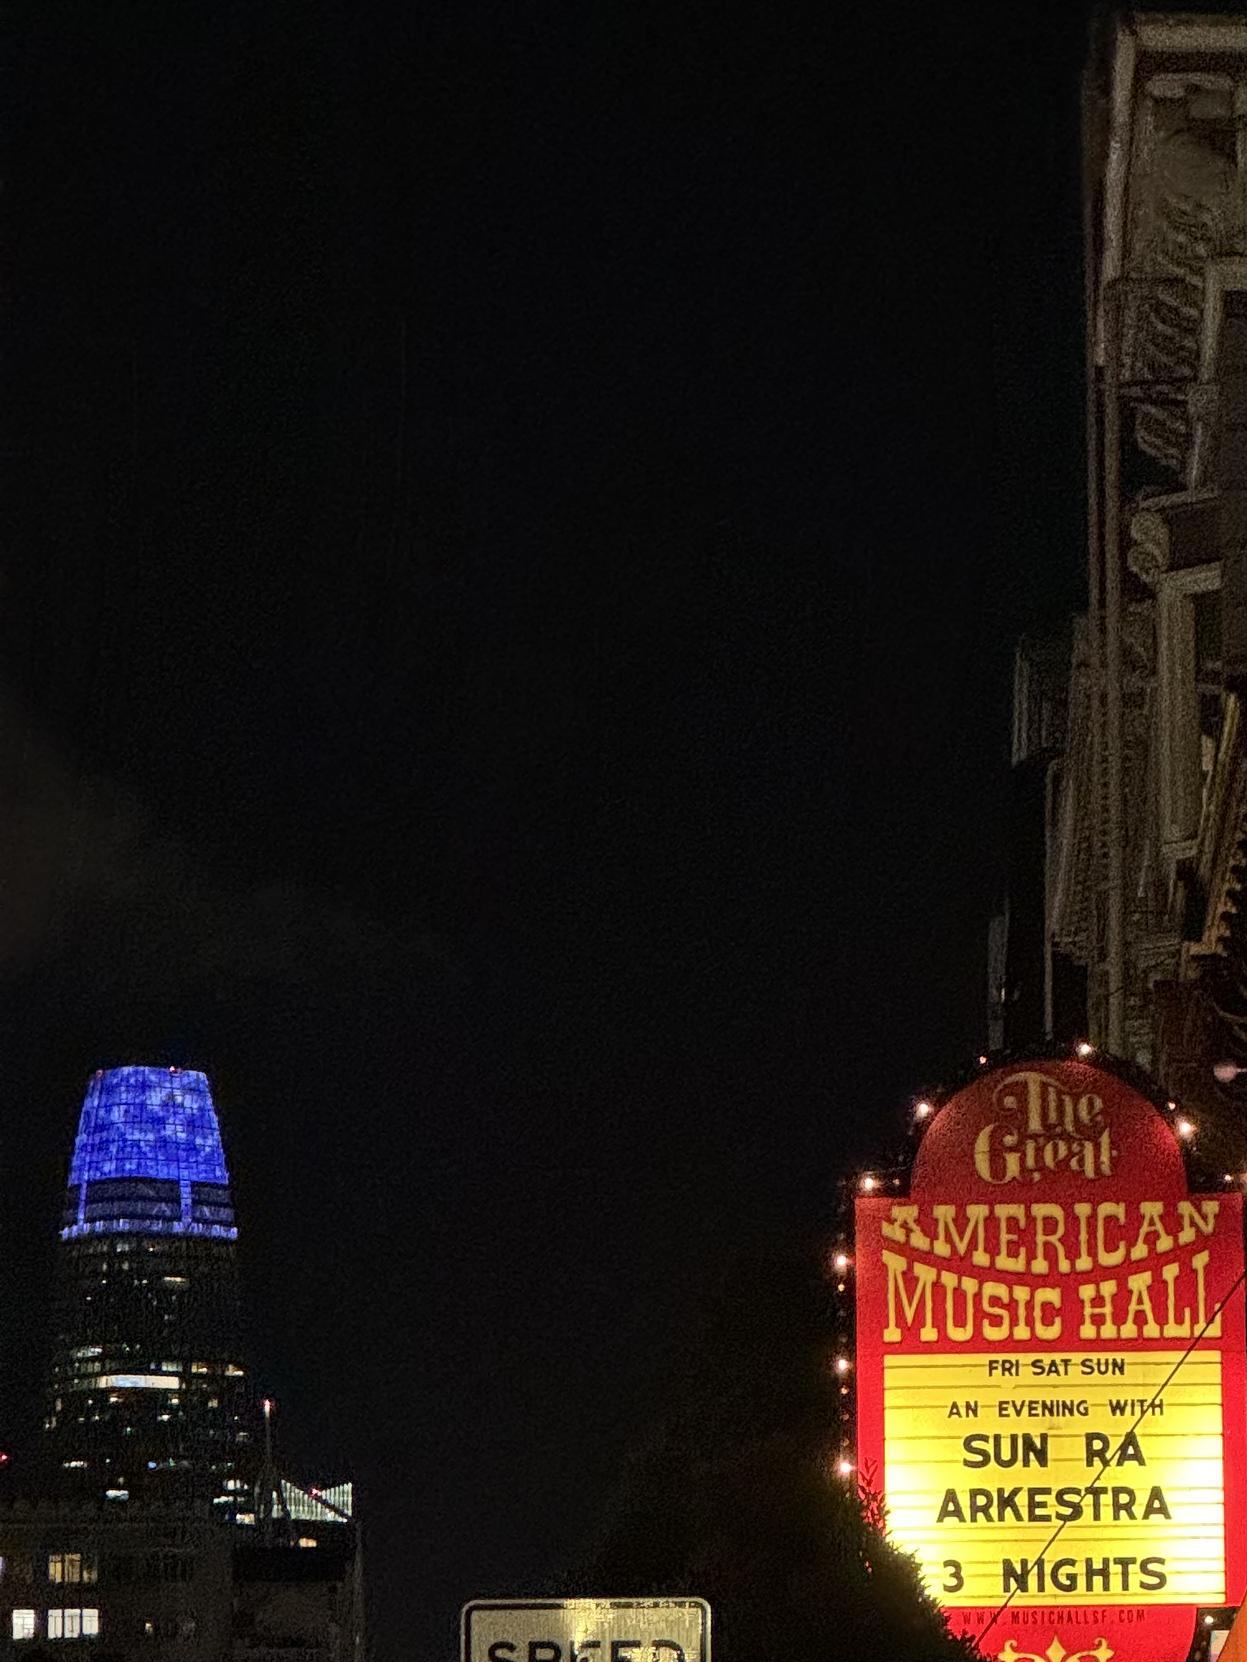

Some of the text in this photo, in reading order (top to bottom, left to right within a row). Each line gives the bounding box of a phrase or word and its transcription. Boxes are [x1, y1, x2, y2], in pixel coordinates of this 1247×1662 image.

[994, 1072, 1103, 1136] The
[974, 1124, 1117, 1184] Great
[882, 1201, 1219, 1274] AMERICAN
[882, 1250, 1222, 1342] MUSIC HALL
[988, 1358, 1126, 1377] FRI SAT SUN
[947, 1399, 1164, 1418] AN EVENING WITH
[962, 1431, 1147, 1469] SUN RA
[936, 1486, 1172, 1523] ARKESTRA
[942, 1557, 1167, 1593] 3 NIGHTS
